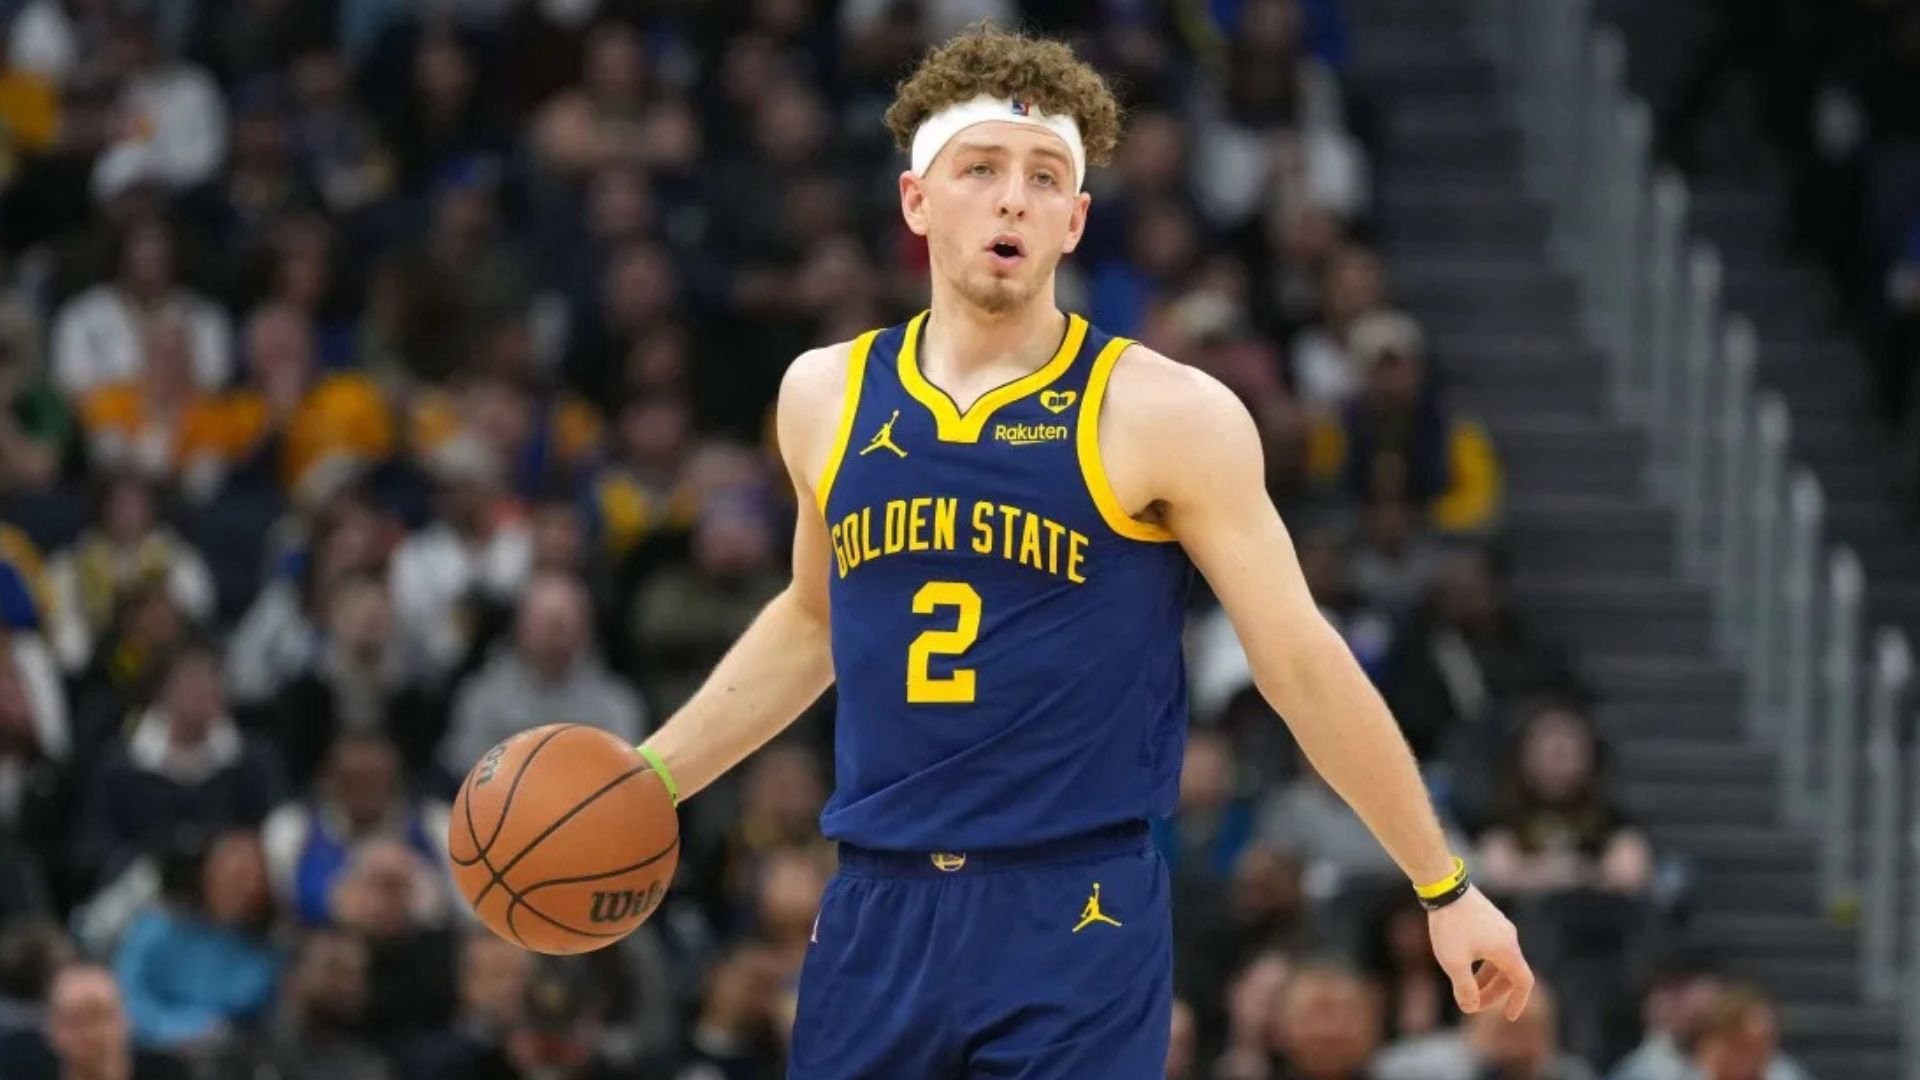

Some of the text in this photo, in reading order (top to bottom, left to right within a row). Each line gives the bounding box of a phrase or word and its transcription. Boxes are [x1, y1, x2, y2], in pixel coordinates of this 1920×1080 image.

[994, 422, 1068, 440] Rakuten
[831, 497, 1089, 583] GOLDEN STATE
[906, 581, 982, 702] 2
[590, 881, 662, 922] Wil
